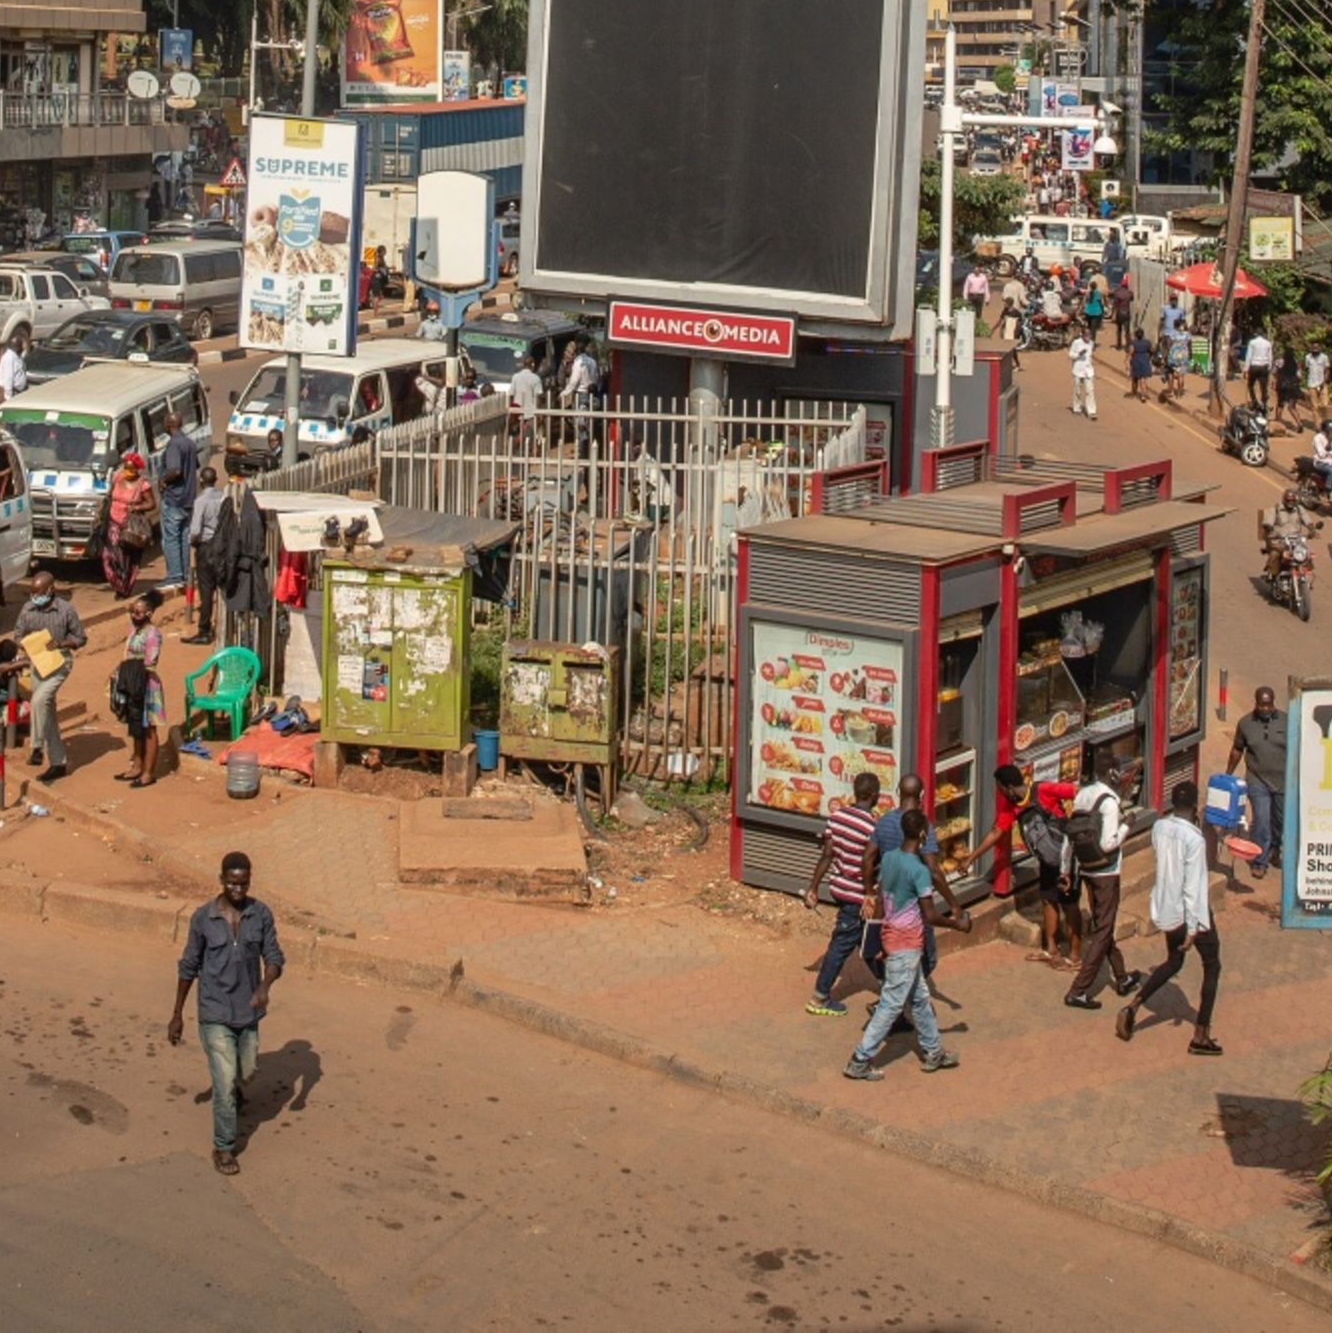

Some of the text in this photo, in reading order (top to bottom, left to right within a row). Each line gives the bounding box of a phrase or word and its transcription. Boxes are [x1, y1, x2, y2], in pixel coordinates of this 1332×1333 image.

[619, 314, 780, 345] ALLIANCE MEDIA
[1307, 821, 1318, 832] &
